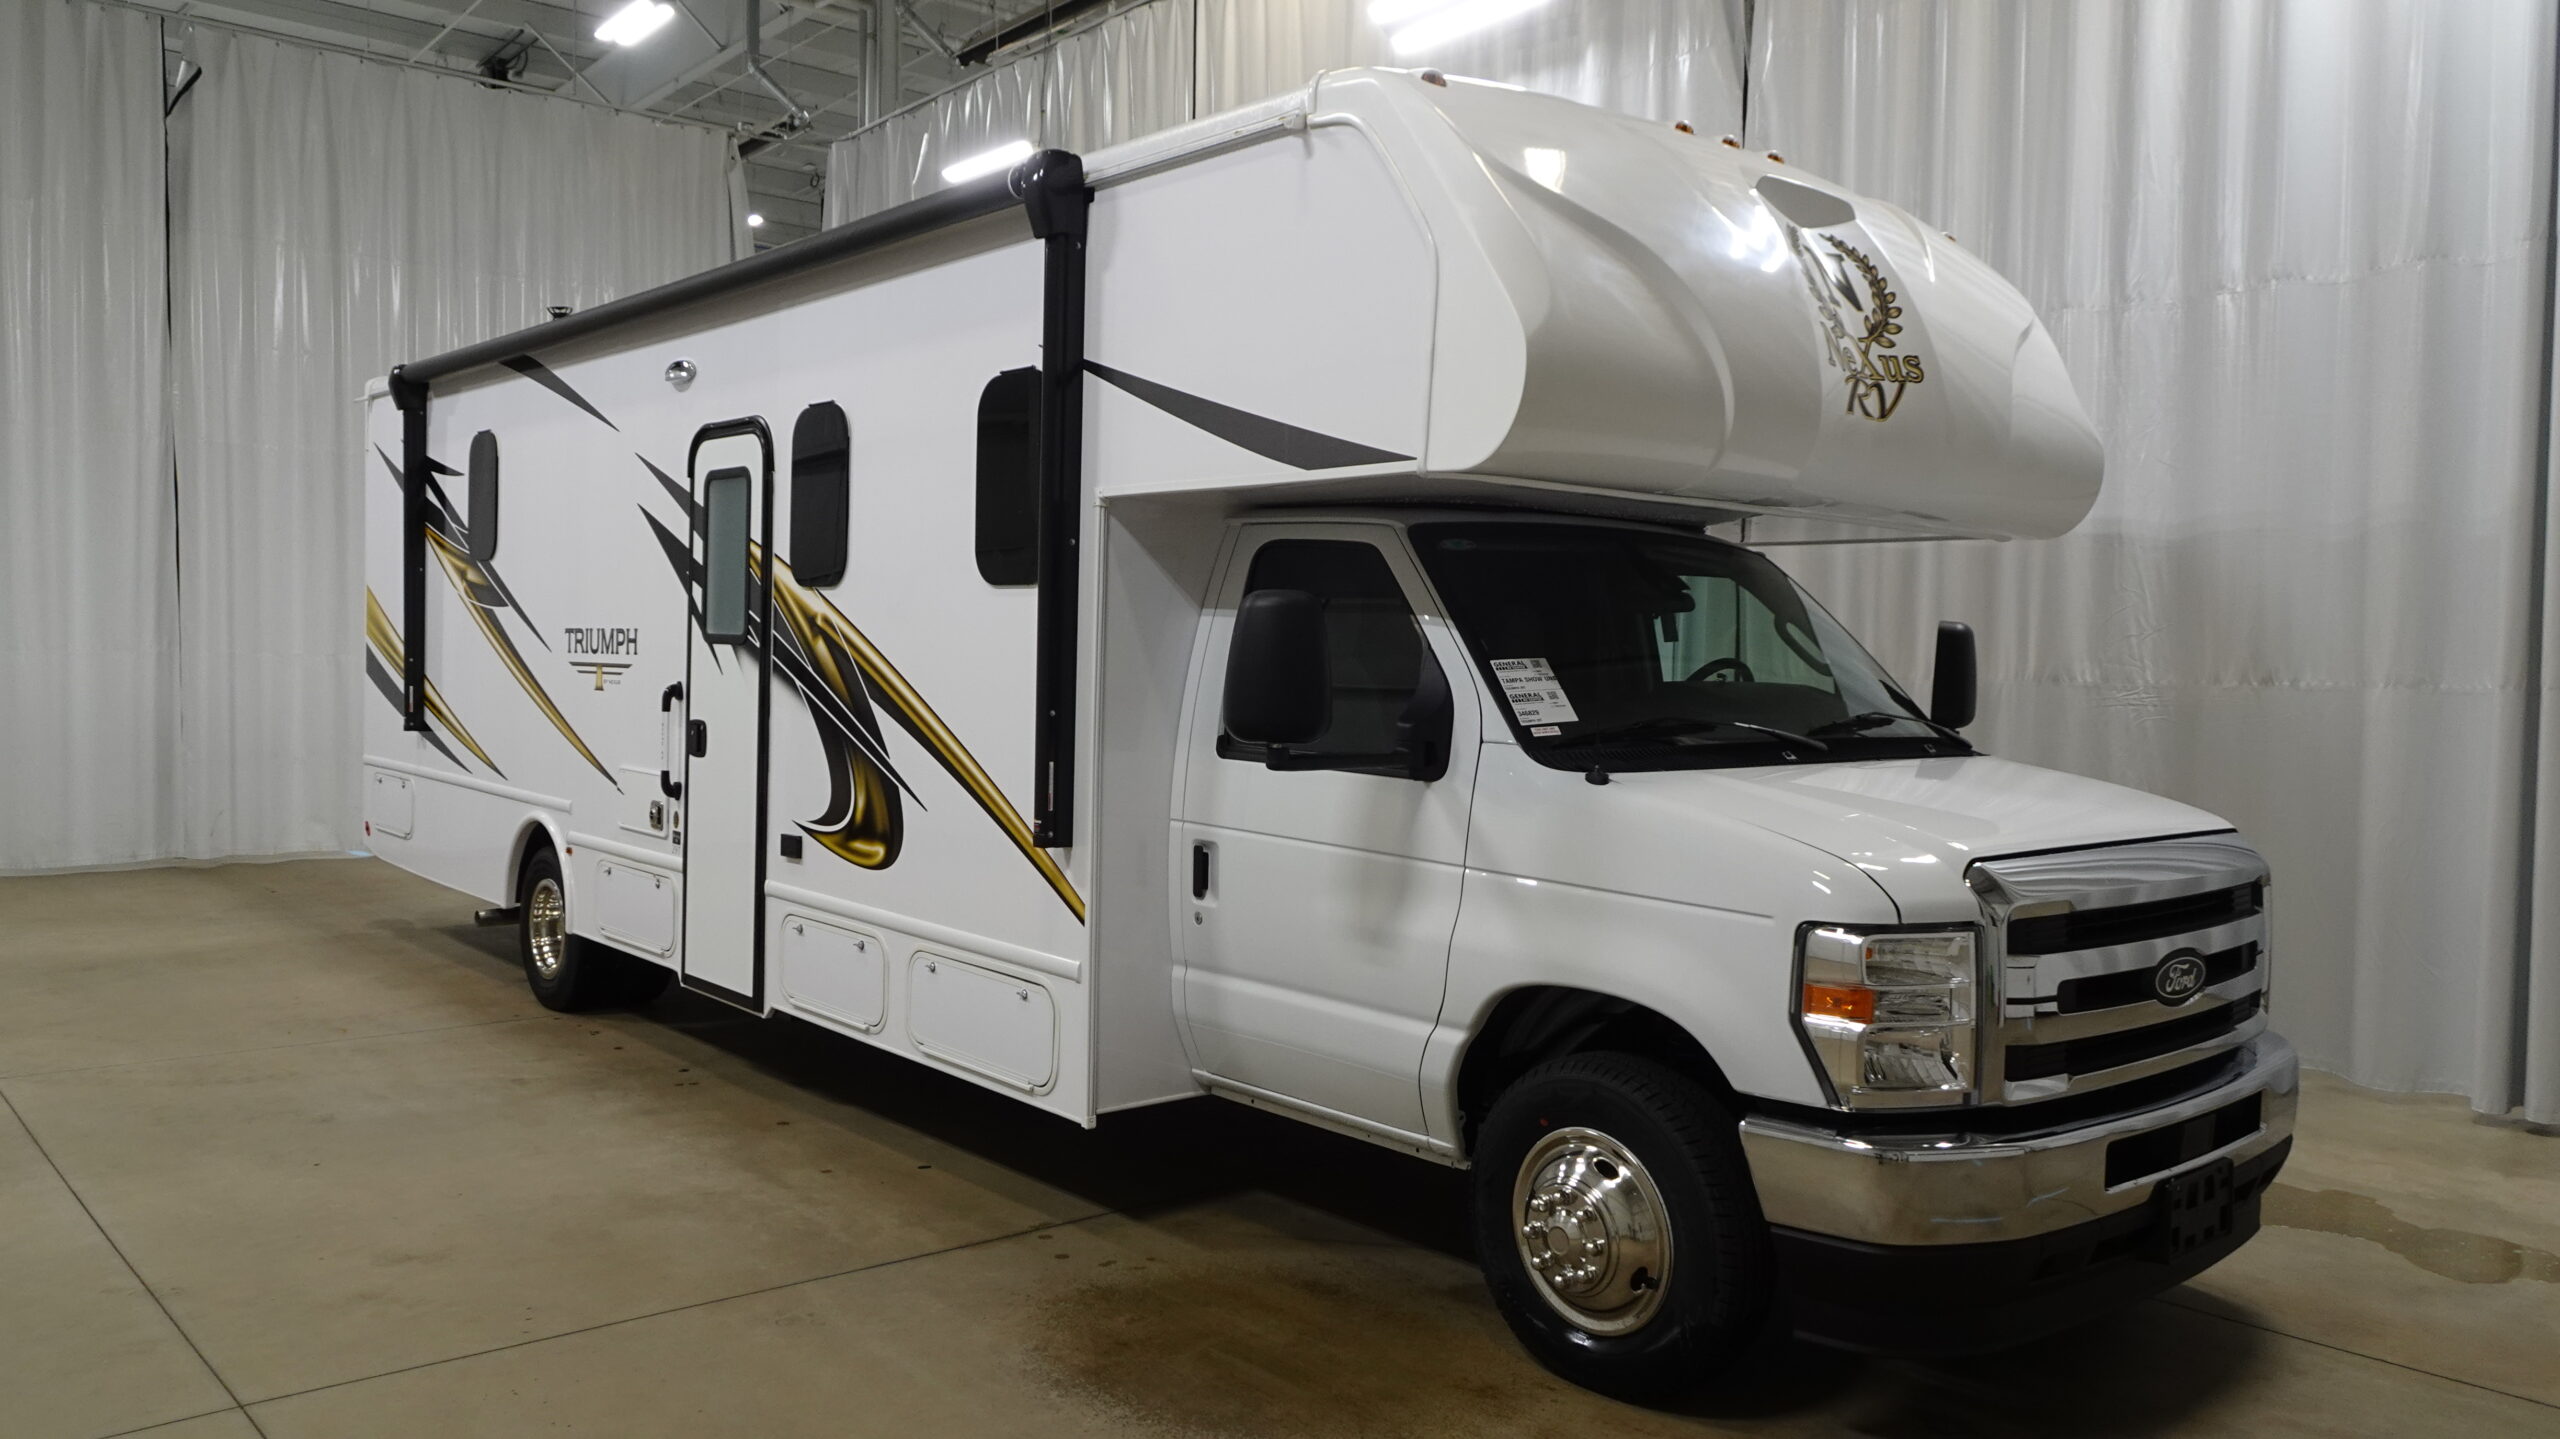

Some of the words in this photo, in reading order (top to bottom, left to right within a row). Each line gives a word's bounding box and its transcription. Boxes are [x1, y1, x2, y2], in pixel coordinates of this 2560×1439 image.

[1845, 374, 1907, 423] RV
[564, 628, 639, 655] TRIUMPH
[2166, 963, 2197, 992] Ford
